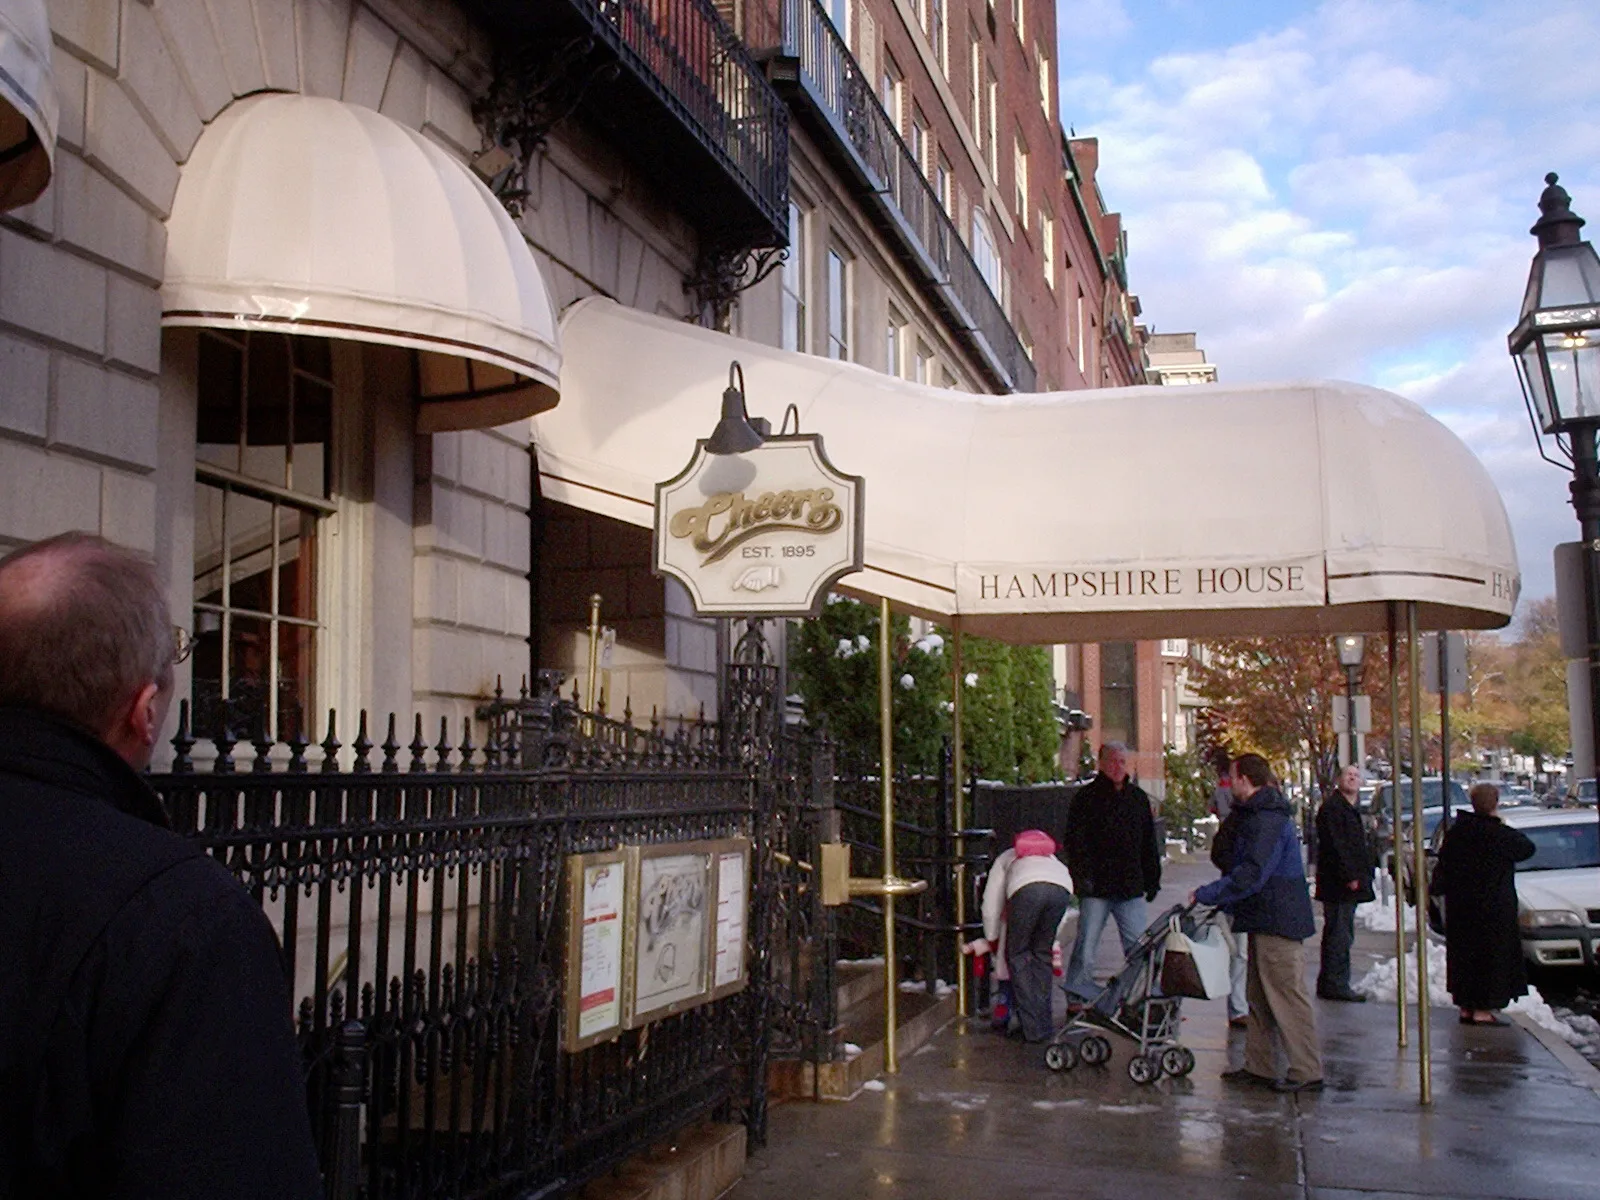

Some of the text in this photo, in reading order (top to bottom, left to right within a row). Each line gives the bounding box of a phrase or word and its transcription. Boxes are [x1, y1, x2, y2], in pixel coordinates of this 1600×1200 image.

[669, 487, 843, 557] Cheers
[741, 545, 816, 559] EST. 1895
[979, 565, 1305, 600] HAMPSHIRE HOUSE
